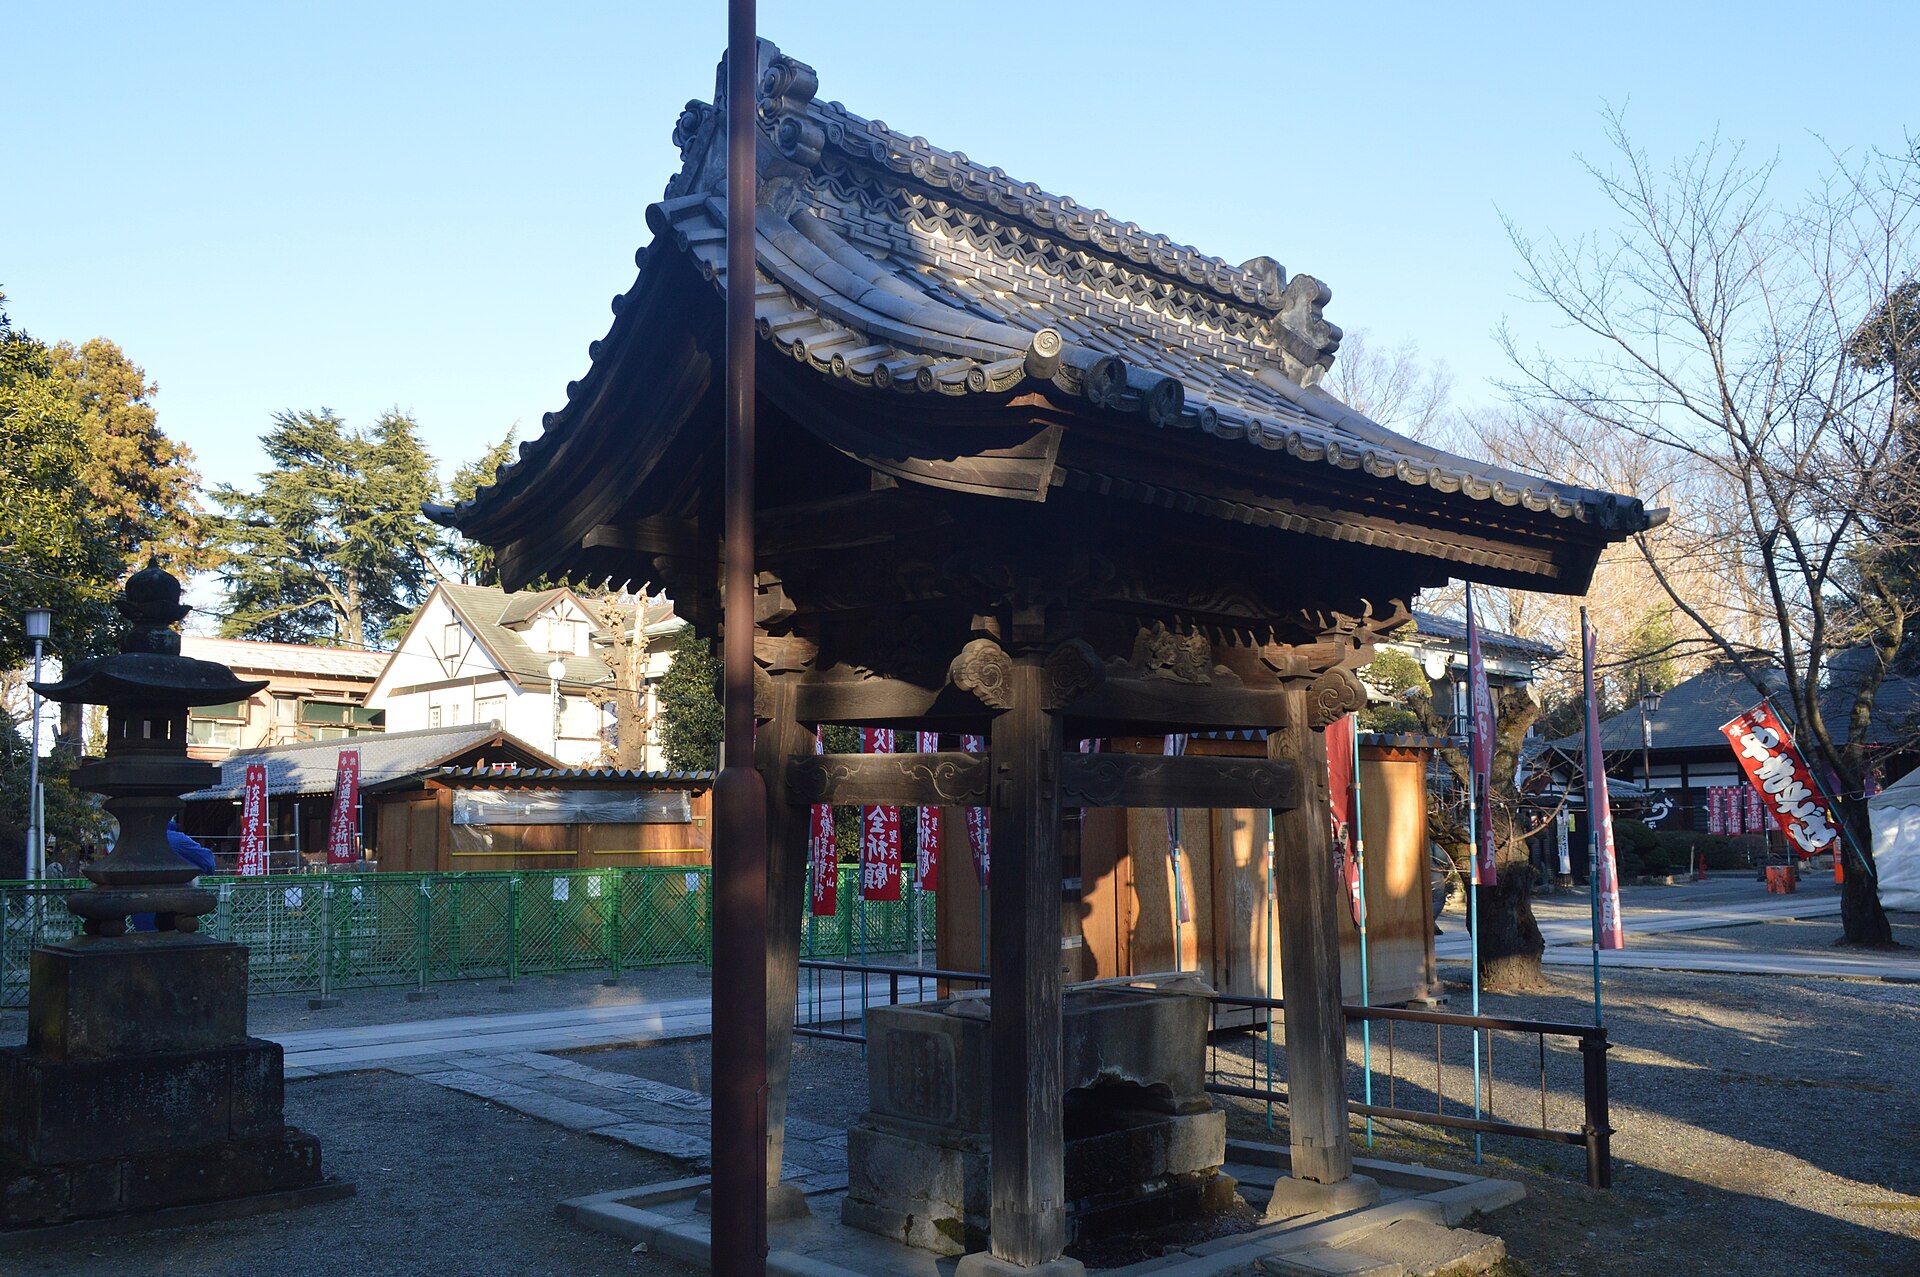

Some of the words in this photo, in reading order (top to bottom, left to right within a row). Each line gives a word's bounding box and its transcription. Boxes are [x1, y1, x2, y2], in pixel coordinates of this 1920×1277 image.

[1728, 709, 1767, 738] 味一番
[241, 783, 261, 877] 交通安全祈願
[334, 768, 353, 858] 交通安全祈願
[1740, 725, 1838, 853] やきそば
